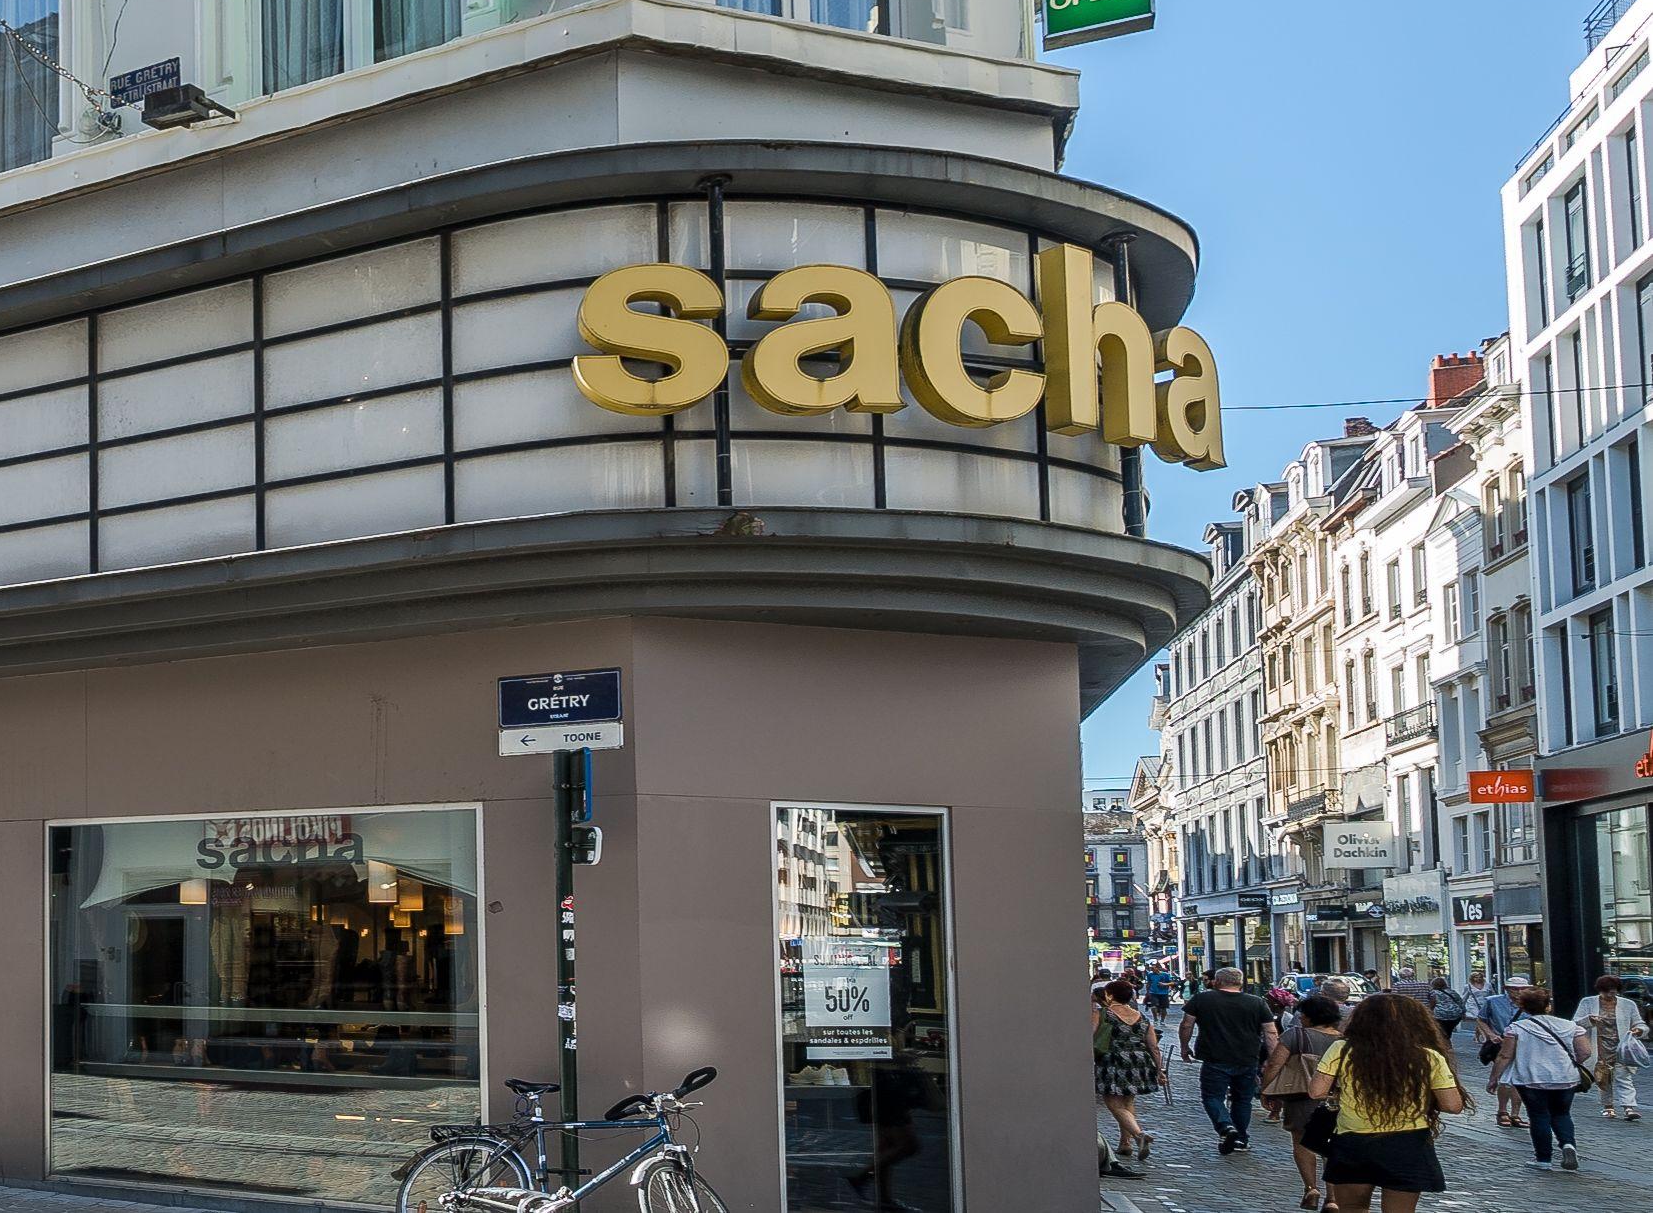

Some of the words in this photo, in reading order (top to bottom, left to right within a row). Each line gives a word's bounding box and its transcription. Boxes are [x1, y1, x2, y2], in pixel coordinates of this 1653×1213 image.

[110, 74, 132, 92] RUE
[572, 242, 1228, 473] sacha
[528, 694, 590, 710] GRÉTRY
[563, 732, 601, 743] TOONE
[1477, 775, 1528, 797] ethias
[1333, 847, 1388, 858] Dachkin
[1459, 899, 1483, 921] Yes
[825, 986, 870, 1013] 50%
